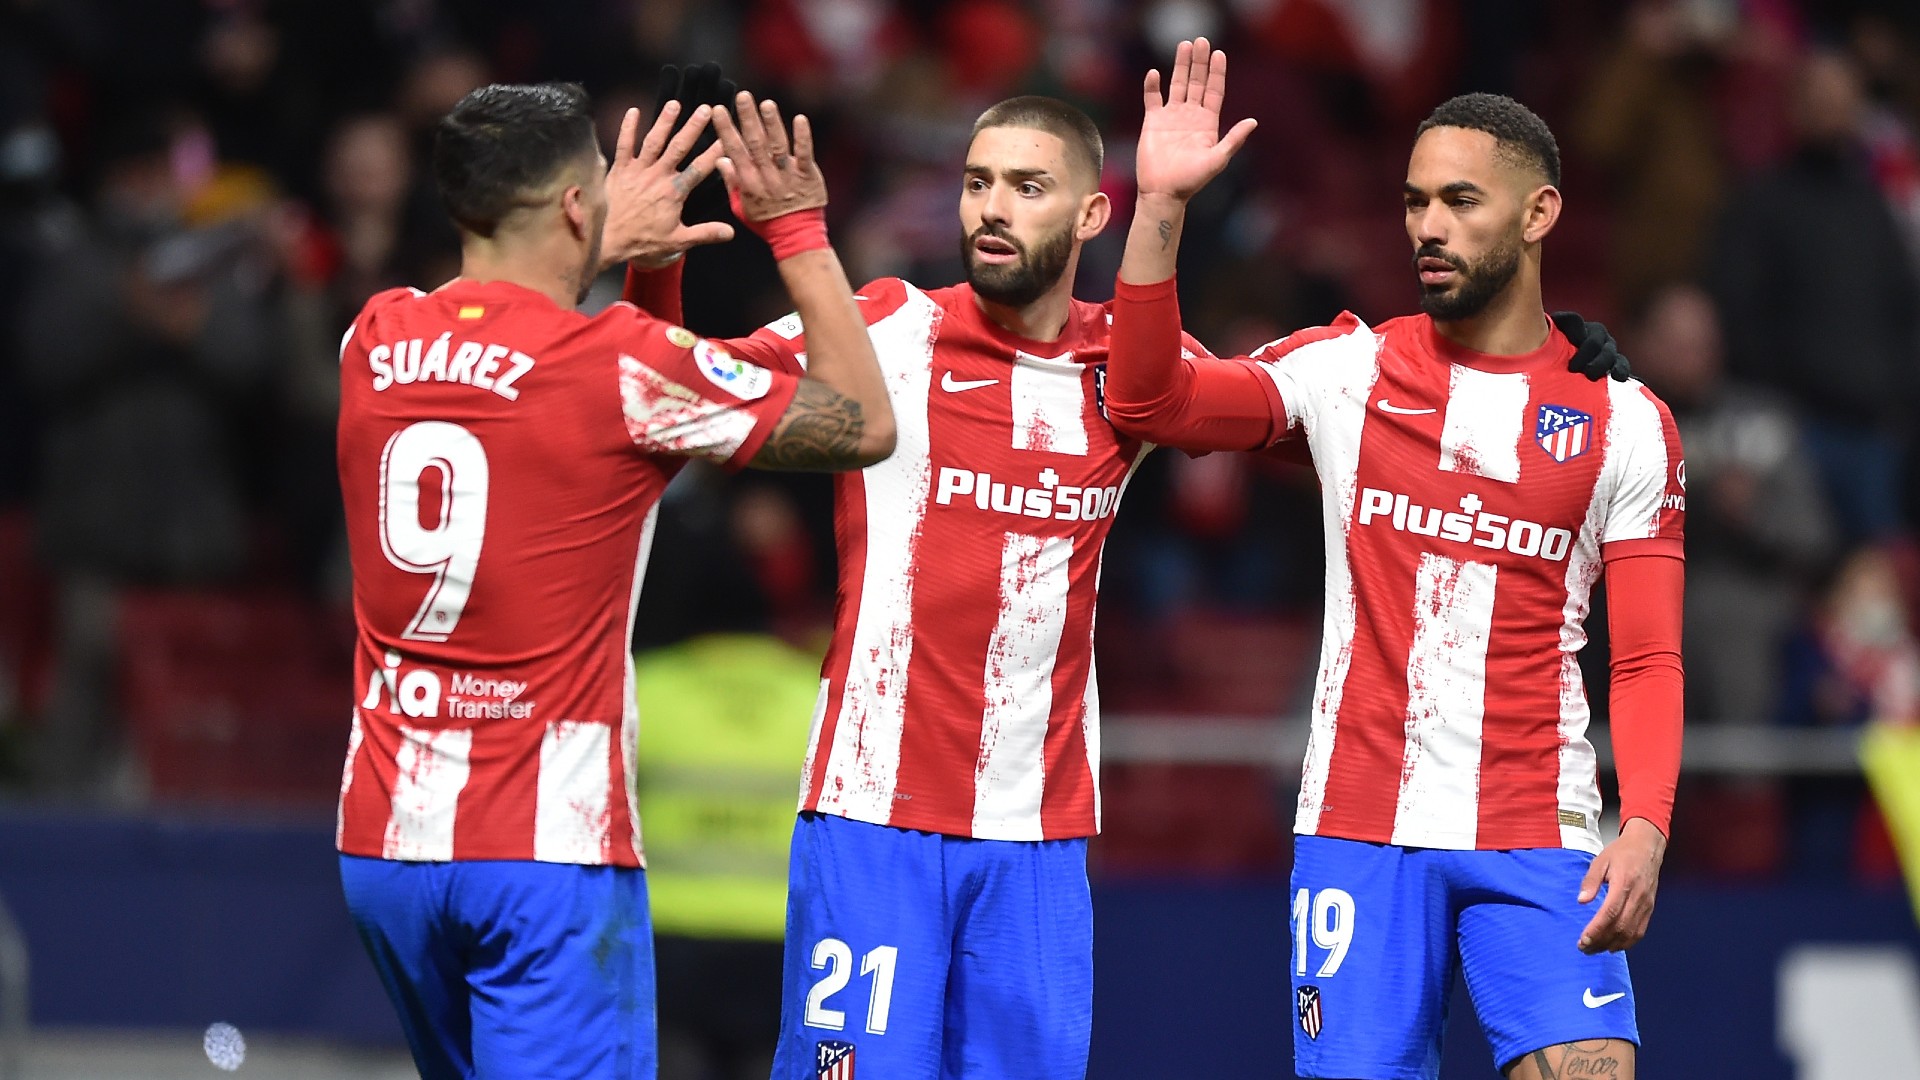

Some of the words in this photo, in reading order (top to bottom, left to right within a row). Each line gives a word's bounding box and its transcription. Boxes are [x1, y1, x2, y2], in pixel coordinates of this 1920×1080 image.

[369, 331, 536, 401] SUÁREZ
[935, 466, 1117, 521] Plus500
[1358, 487, 1572, 562] Plus500
[378, 420, 490, 643] 9
[446, 697, 536, 719] Transfer
[450, 672, 528, 701] Money
[1293, 887, 1356, 978] 19
[803, 937, 899, 1036] 21
